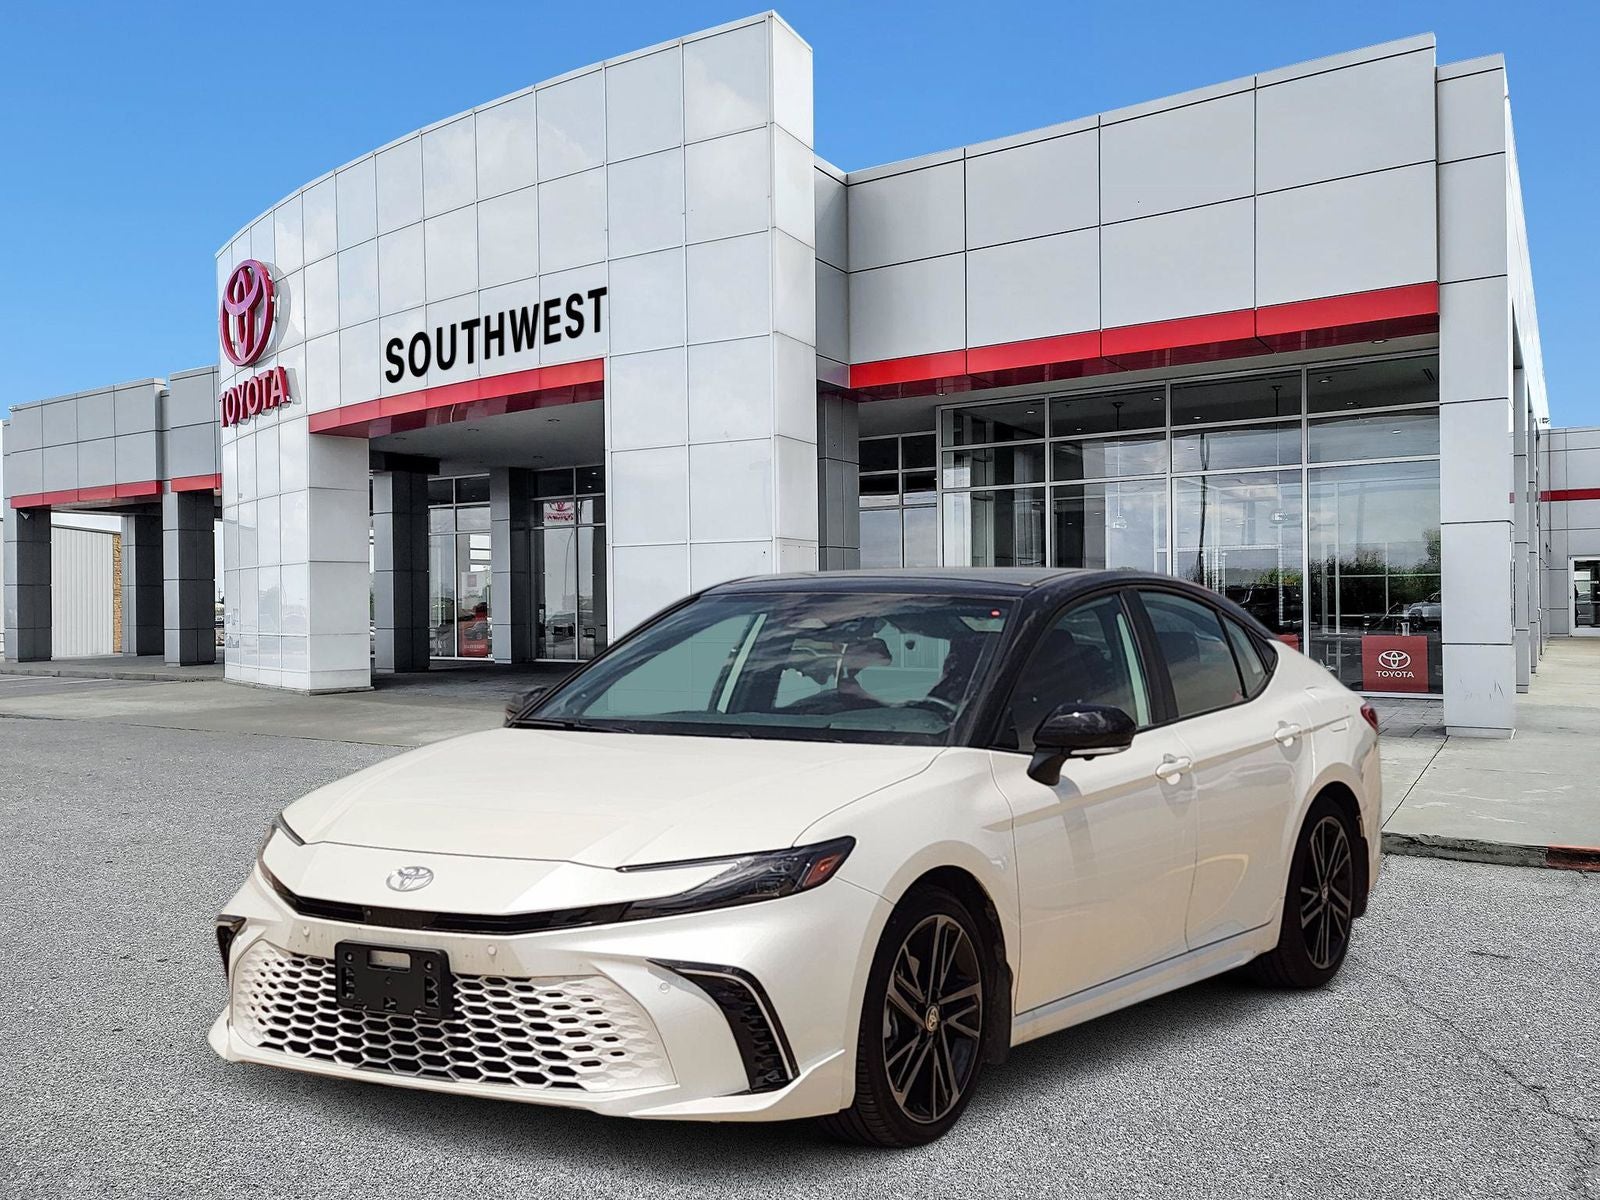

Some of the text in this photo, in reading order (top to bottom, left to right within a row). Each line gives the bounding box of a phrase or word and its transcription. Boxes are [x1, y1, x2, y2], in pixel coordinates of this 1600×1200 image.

[385, 286, 608, 384] SOUTHWEST
[219, 366, 292, 428] TOYOTA
[1376, 670, 1415, 678] TOYOTA
